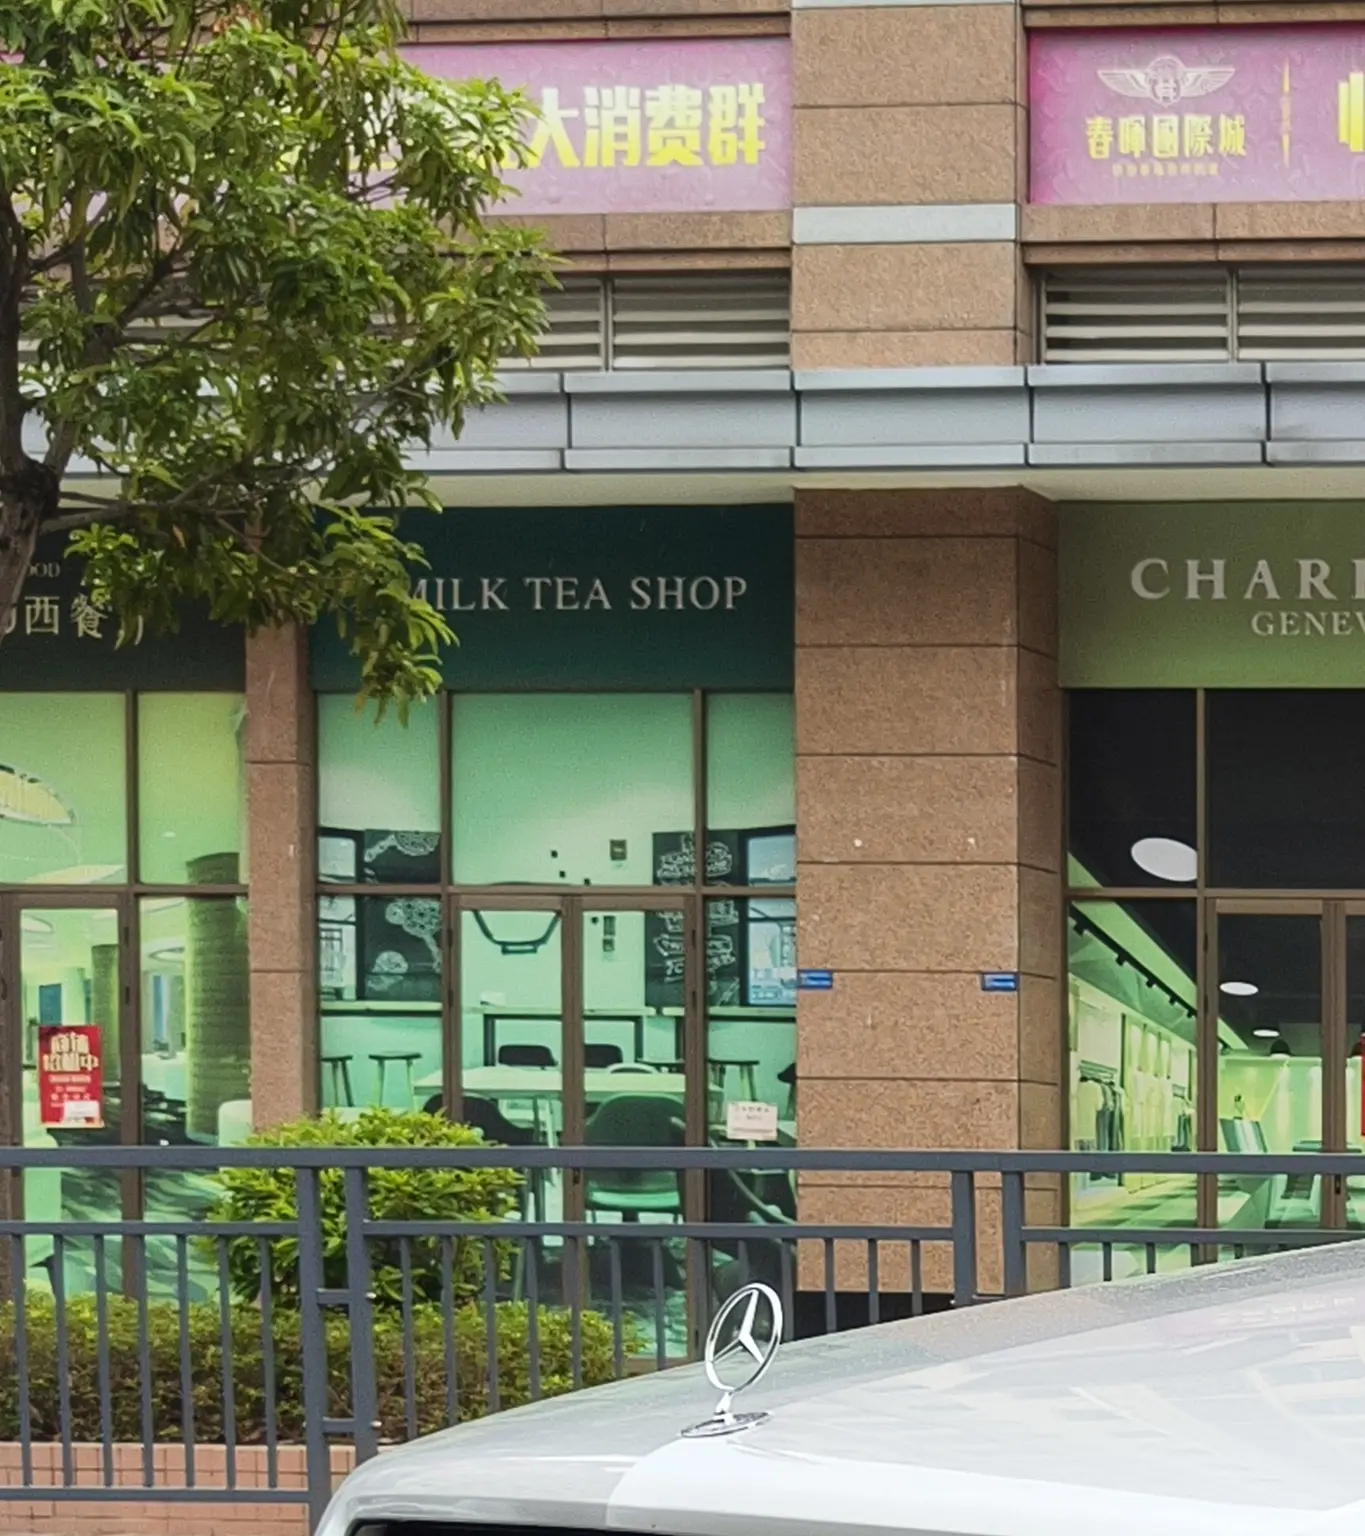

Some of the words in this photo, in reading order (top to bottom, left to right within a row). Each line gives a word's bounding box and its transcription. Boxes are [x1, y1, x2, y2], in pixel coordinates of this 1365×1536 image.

[497, 83, 766, 168] 大消费群
[4, 591, 145, 651] 西餐
[524, 577, 613, 611] TEA
[629, 575, 748, 611] SHOP
